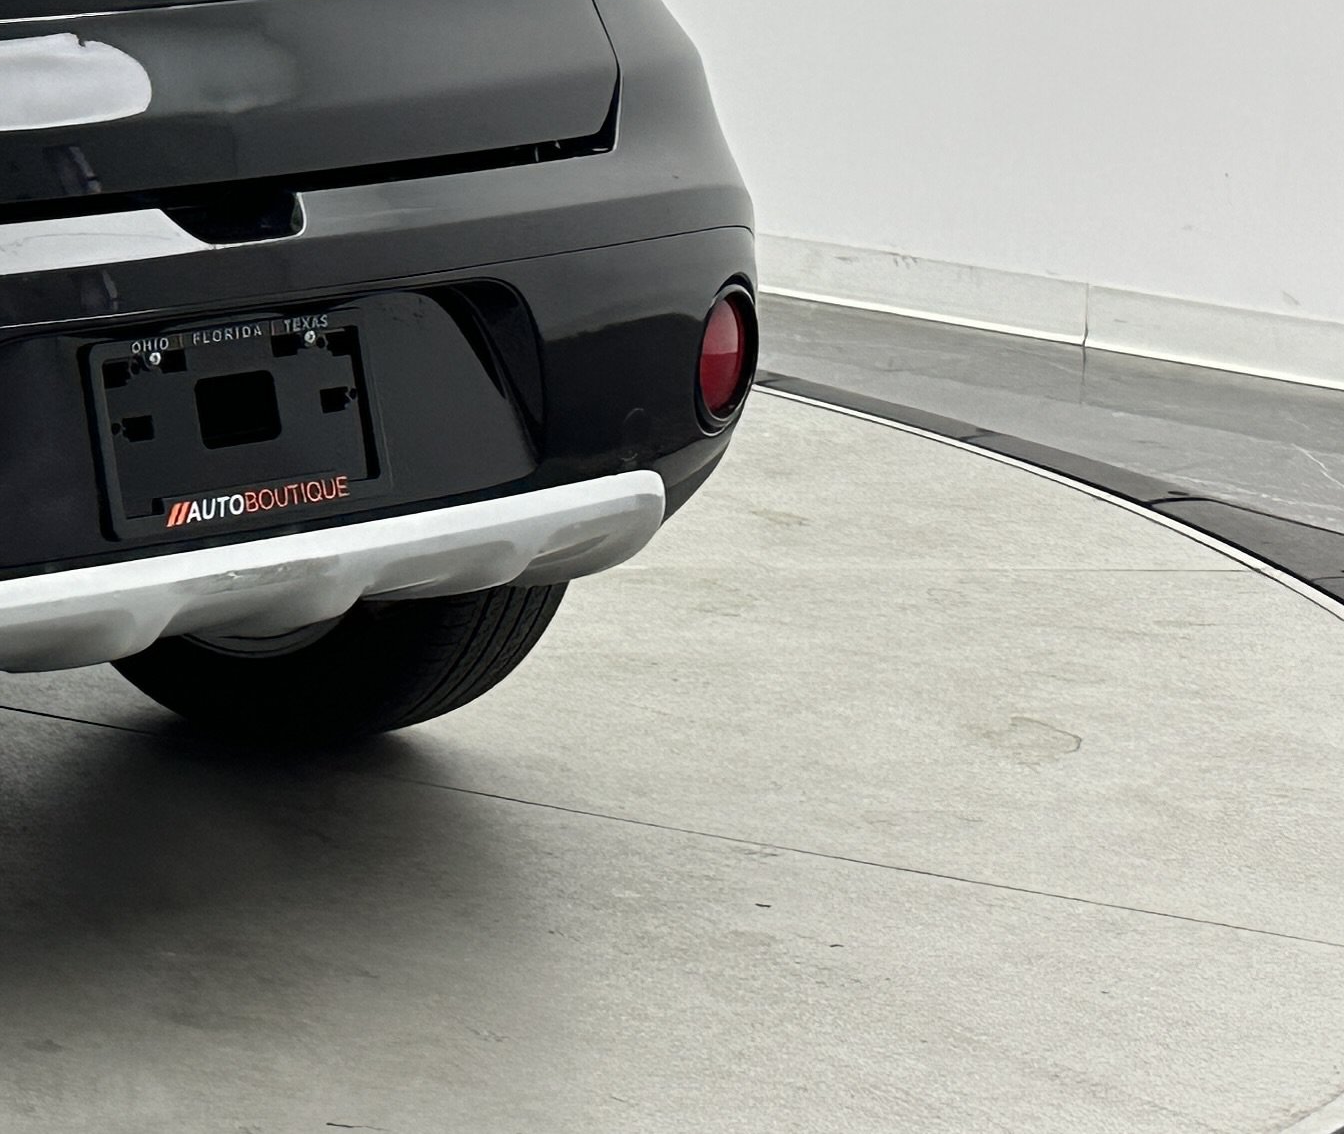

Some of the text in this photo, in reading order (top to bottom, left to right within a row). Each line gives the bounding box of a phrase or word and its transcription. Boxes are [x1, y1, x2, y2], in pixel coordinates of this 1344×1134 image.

[130, 314, 329, 354] OHIO FLORIDA TEXAS
[185, 475, 351, 525] AUTOBOUTIQUE
